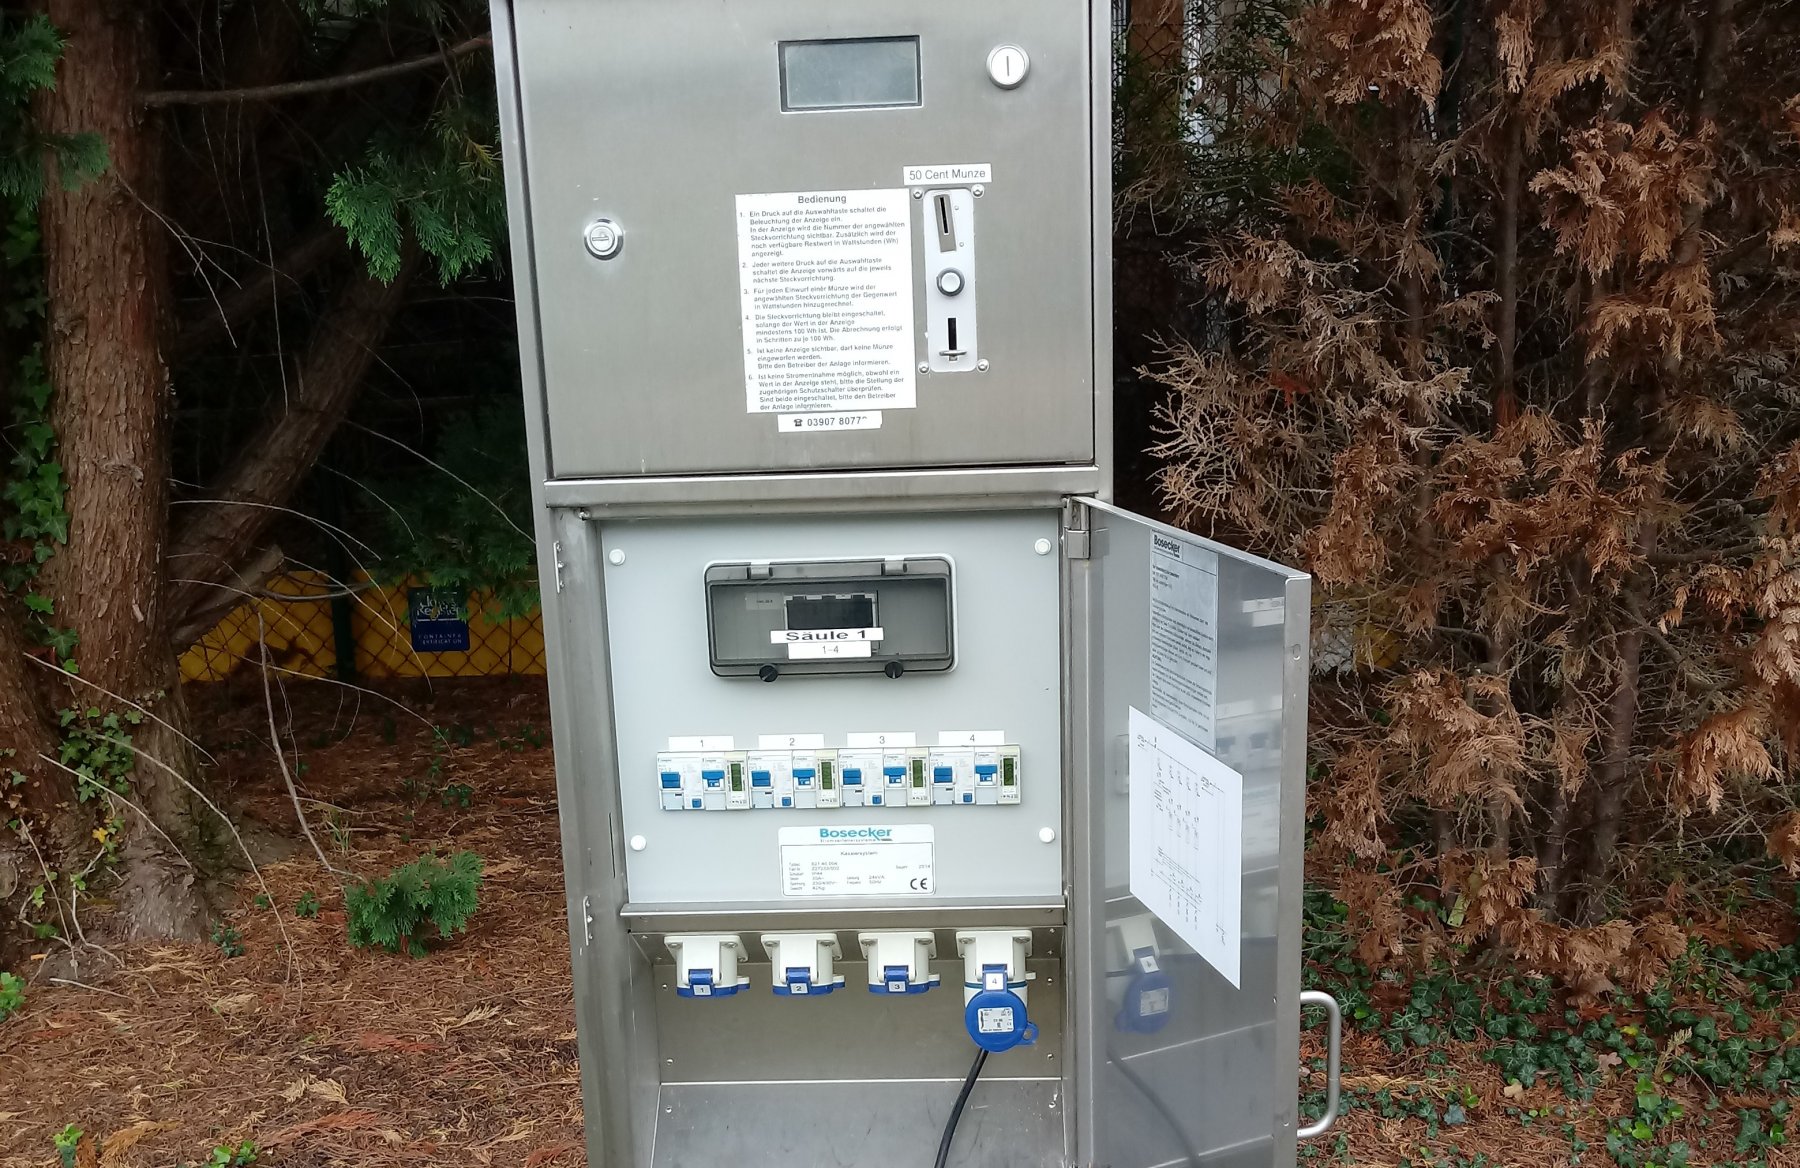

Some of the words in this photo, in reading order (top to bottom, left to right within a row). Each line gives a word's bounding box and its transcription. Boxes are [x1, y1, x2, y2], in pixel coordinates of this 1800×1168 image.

[909, 170, 922, 180] 50
[925, 170, 948, 179] Cent
[797, 194, 846, 205] Bedienung
[807, 418, 835, 426] 03907
[838, 416, 868, 426] 8077
[1154, 534, 1180, 555] Bosecker
[786, 630, 848, 640] Säule
[857, 630, 866, 639] 1
[822, 645, 839, 654] 1-4
[789, 737, 795, 746] 2
[879, 736, 885, 744] 3
[969, 734, 975, 742] 4
[700, 739, 704, 748] 1
[820, 827, 892, 840] Bosecker
